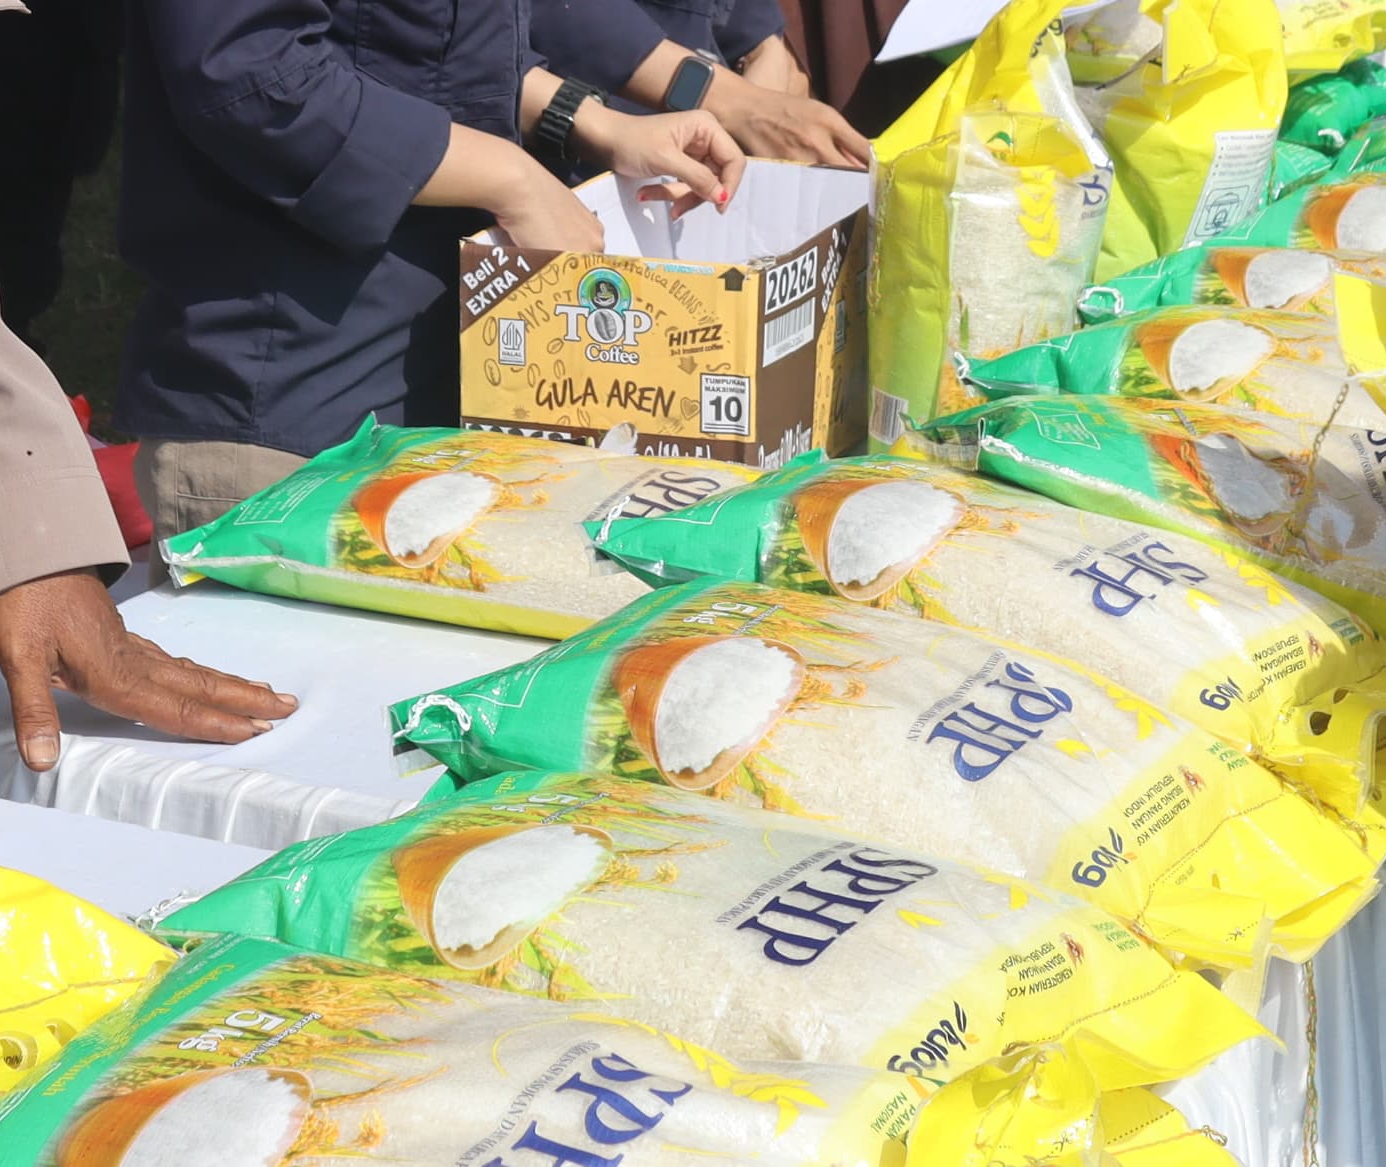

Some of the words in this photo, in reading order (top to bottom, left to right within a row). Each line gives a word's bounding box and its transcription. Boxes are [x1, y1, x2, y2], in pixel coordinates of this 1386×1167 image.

[463, 258, 495, 291] Beli
[492, 247, 509, 266] 2
[767, 250, 816, 311] 20262
[466, 270, 519, 316] EXTRA
[517, 256, 532, 274] 1
[555, 304, 652, 347] TOP
[669, 324, 723, 348] HITZZ
[585, 344, 640, 365] Coffee
[704, 377, 746, 387] TUMPUKAN
[704, 385, 746, 395] MAKSIMUM
[535, 377, 599, 411] GULA
[606, 379, 676, 418] AREN
[708, 396, 743, 423] 10
[926, 661, 1073, 783] SPHP
[1131, 801, 1162, 830] PANGAN
[735, 847, 938, 967] SPHP
[224, 1009, 286, 1031] 5
[177, 1025, 243, 1052] kg
